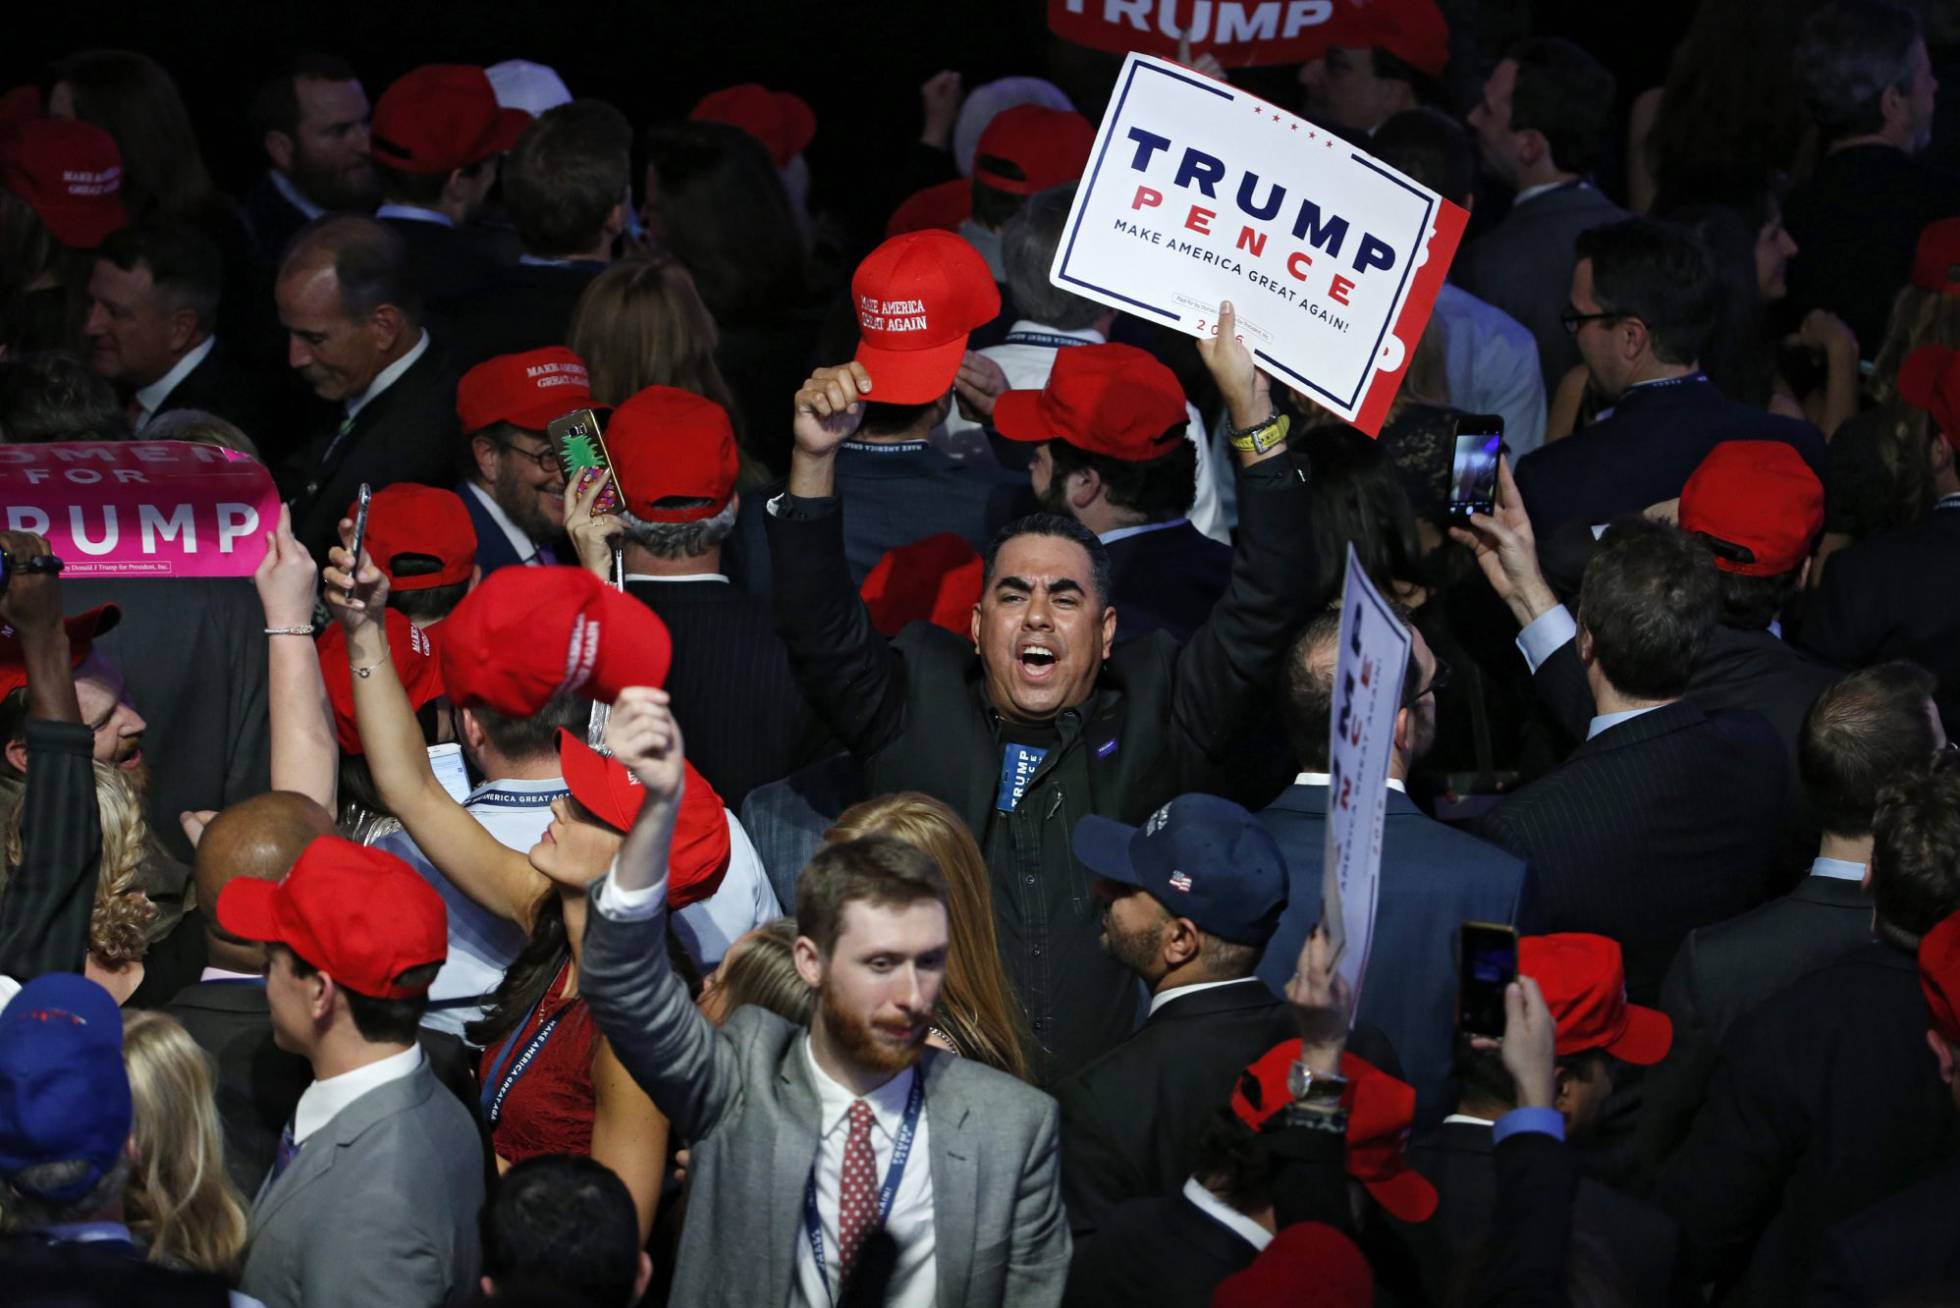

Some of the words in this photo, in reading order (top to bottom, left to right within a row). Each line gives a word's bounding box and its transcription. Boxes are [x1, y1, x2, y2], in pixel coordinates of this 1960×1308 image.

[1127, 126, 1396, 274] TRUMP
[1131, 185, 1356, 307] PENCE
[1114, 218, 1162, 245] MAKE
[1166, 238, 1242, 275] AMERICA
[1248, 270, 1296, 302] GREAT
[1299, 299, 1349, 334] AGAIN!
[882, 299, 926, 315] AMERICA
[887, 316, 928, 332] AGAIN
[1196, 319, 1245, 345] 206
[24, 468, 151, 484] FOR
[7, 502, 259, 556] RUMP
[1011, 750, 1029, 808] TRUMP
[519, 795, 549, 803] GREAT
[537, 1020, 557, 1042] MAKE
[511, 1041, 540, 1076] AMERICA
[496, 1076, 513, 1104] GREAT
